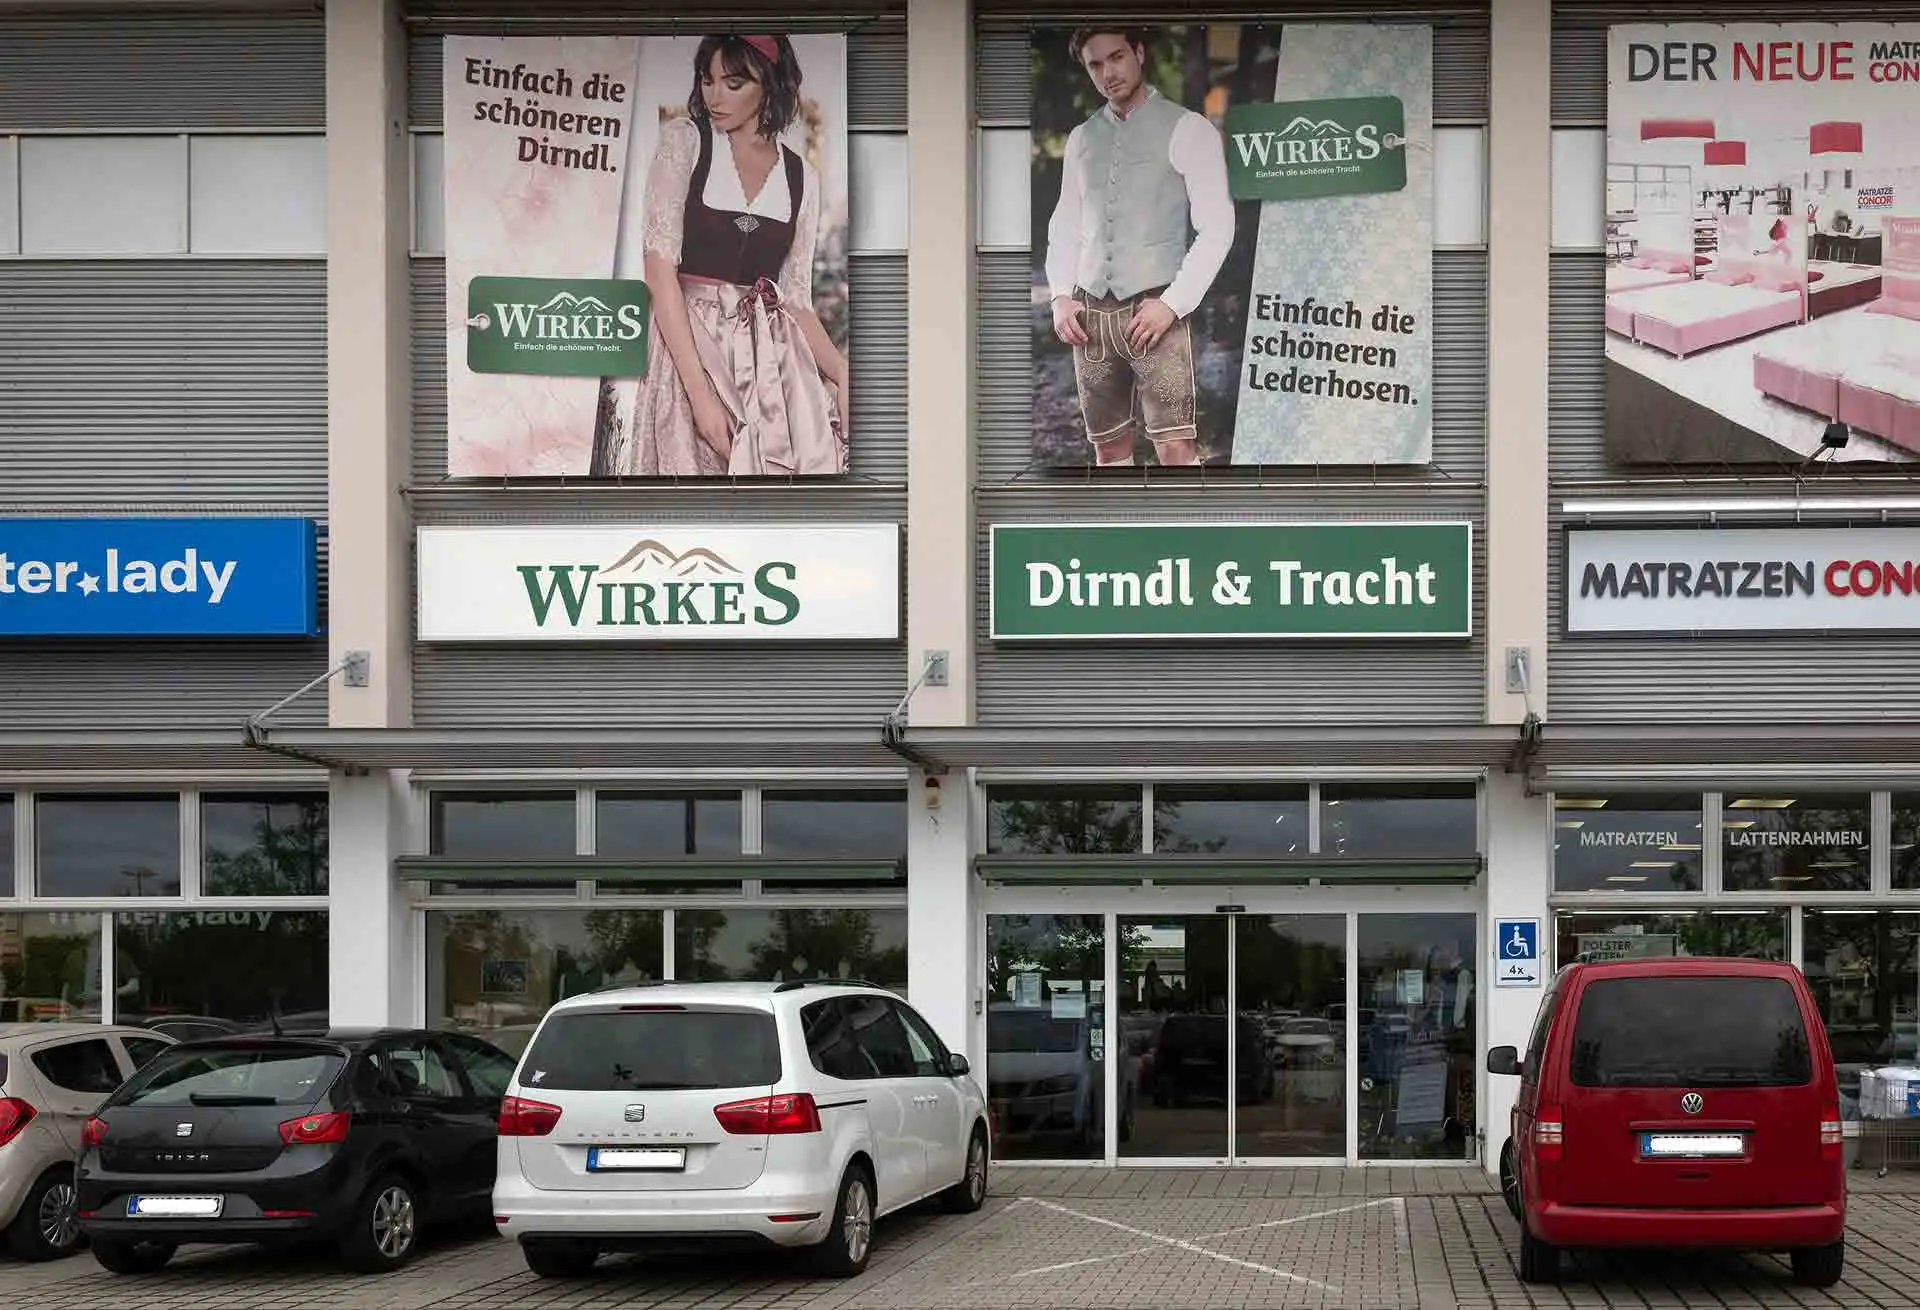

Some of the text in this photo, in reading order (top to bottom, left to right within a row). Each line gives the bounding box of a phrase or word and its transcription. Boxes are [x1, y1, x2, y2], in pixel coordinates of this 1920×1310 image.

[465, 58, 626, 103] Einfach die
[1628, 42, 1855, 81] DER NEUE
[1869, 61, 1920, 83] CON
[474, 97, 621, 138] schöneren
[518, 136, 617, 173] Dirndl.
[1232, 125, 1380, 167] WIRKES
[1255, 169, 1285, 178] Einfach
[1286, 168, 1298, 176] die
[494, 303, 642, 341] WIRKES
[1255, 294, 1416, 334] Einfach die
[514, 342, 544, 351] Einfach
[545, 342, 557, 351] die
[1250, 330, 1397, 368] schöneren
[1248, 364, 1418, 405] Lederhosen.
[106, 548, 237, 604] lady
[516, 561, 801, 627] WIRKES
[1025, 557, 1437, 607] Dirndl & Tracht
[1580, 559, 1920, 599] MATRATZEN CON
[1580, 831, 1678, 846] MATRATZEN
[1730, 831, 1863, 846] LATTENRAHMEN
[1509, 964, 1525, 975] 4x
